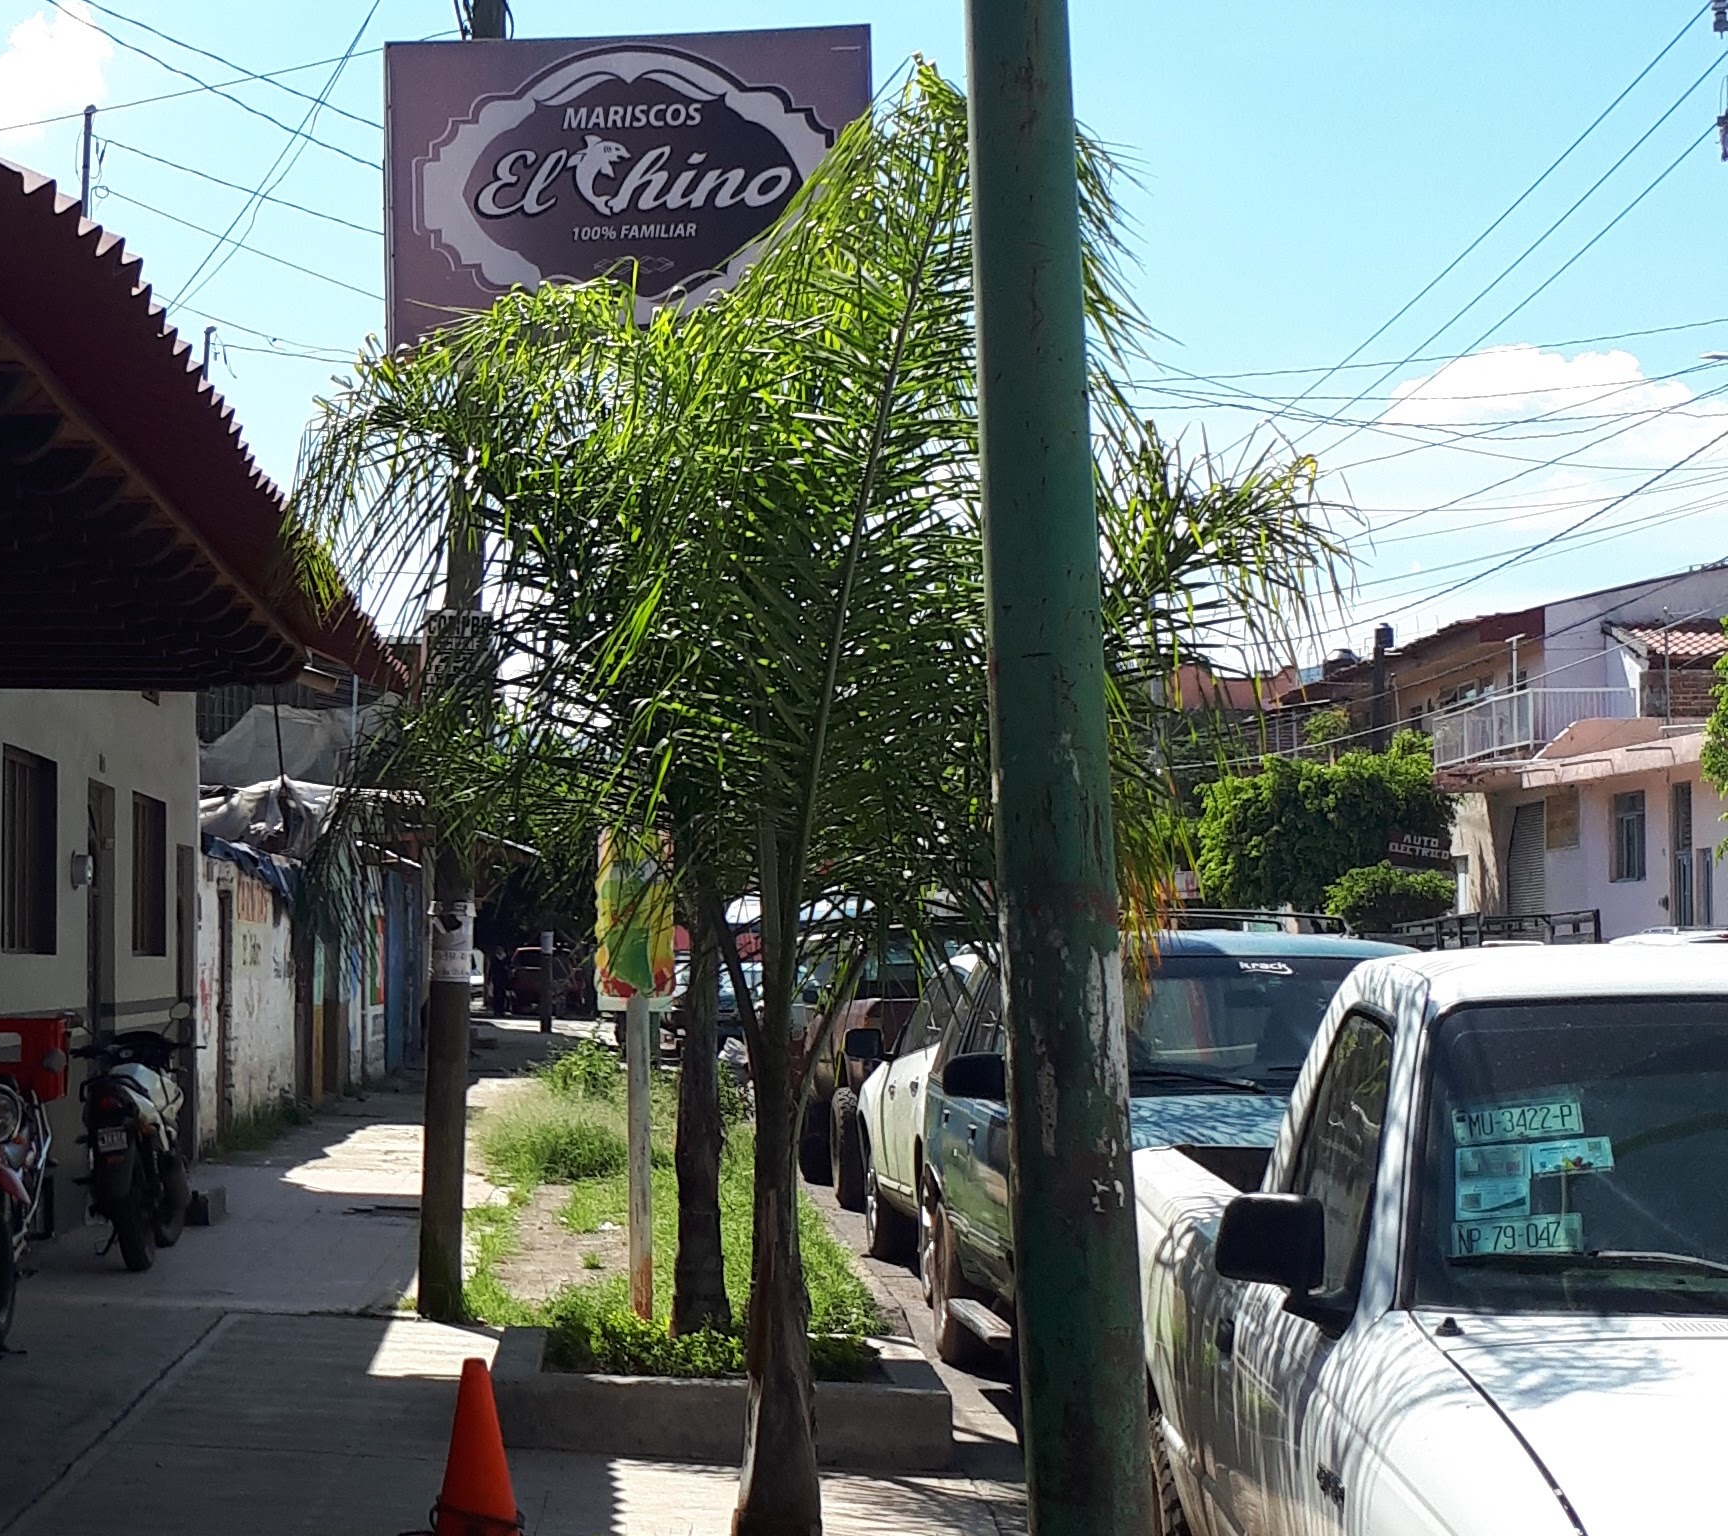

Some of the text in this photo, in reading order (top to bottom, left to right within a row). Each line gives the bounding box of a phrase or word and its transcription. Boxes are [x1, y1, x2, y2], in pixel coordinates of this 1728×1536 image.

[562, 103, 703, 130] MARISCOS
[475, 149, 568, 219] El
[572, 223, 697, 241] 100% FAMILIAR
[1403, 834, 1439, 848] AUTO
[1468, 1104, 1572, 1138] MU-3422-P
